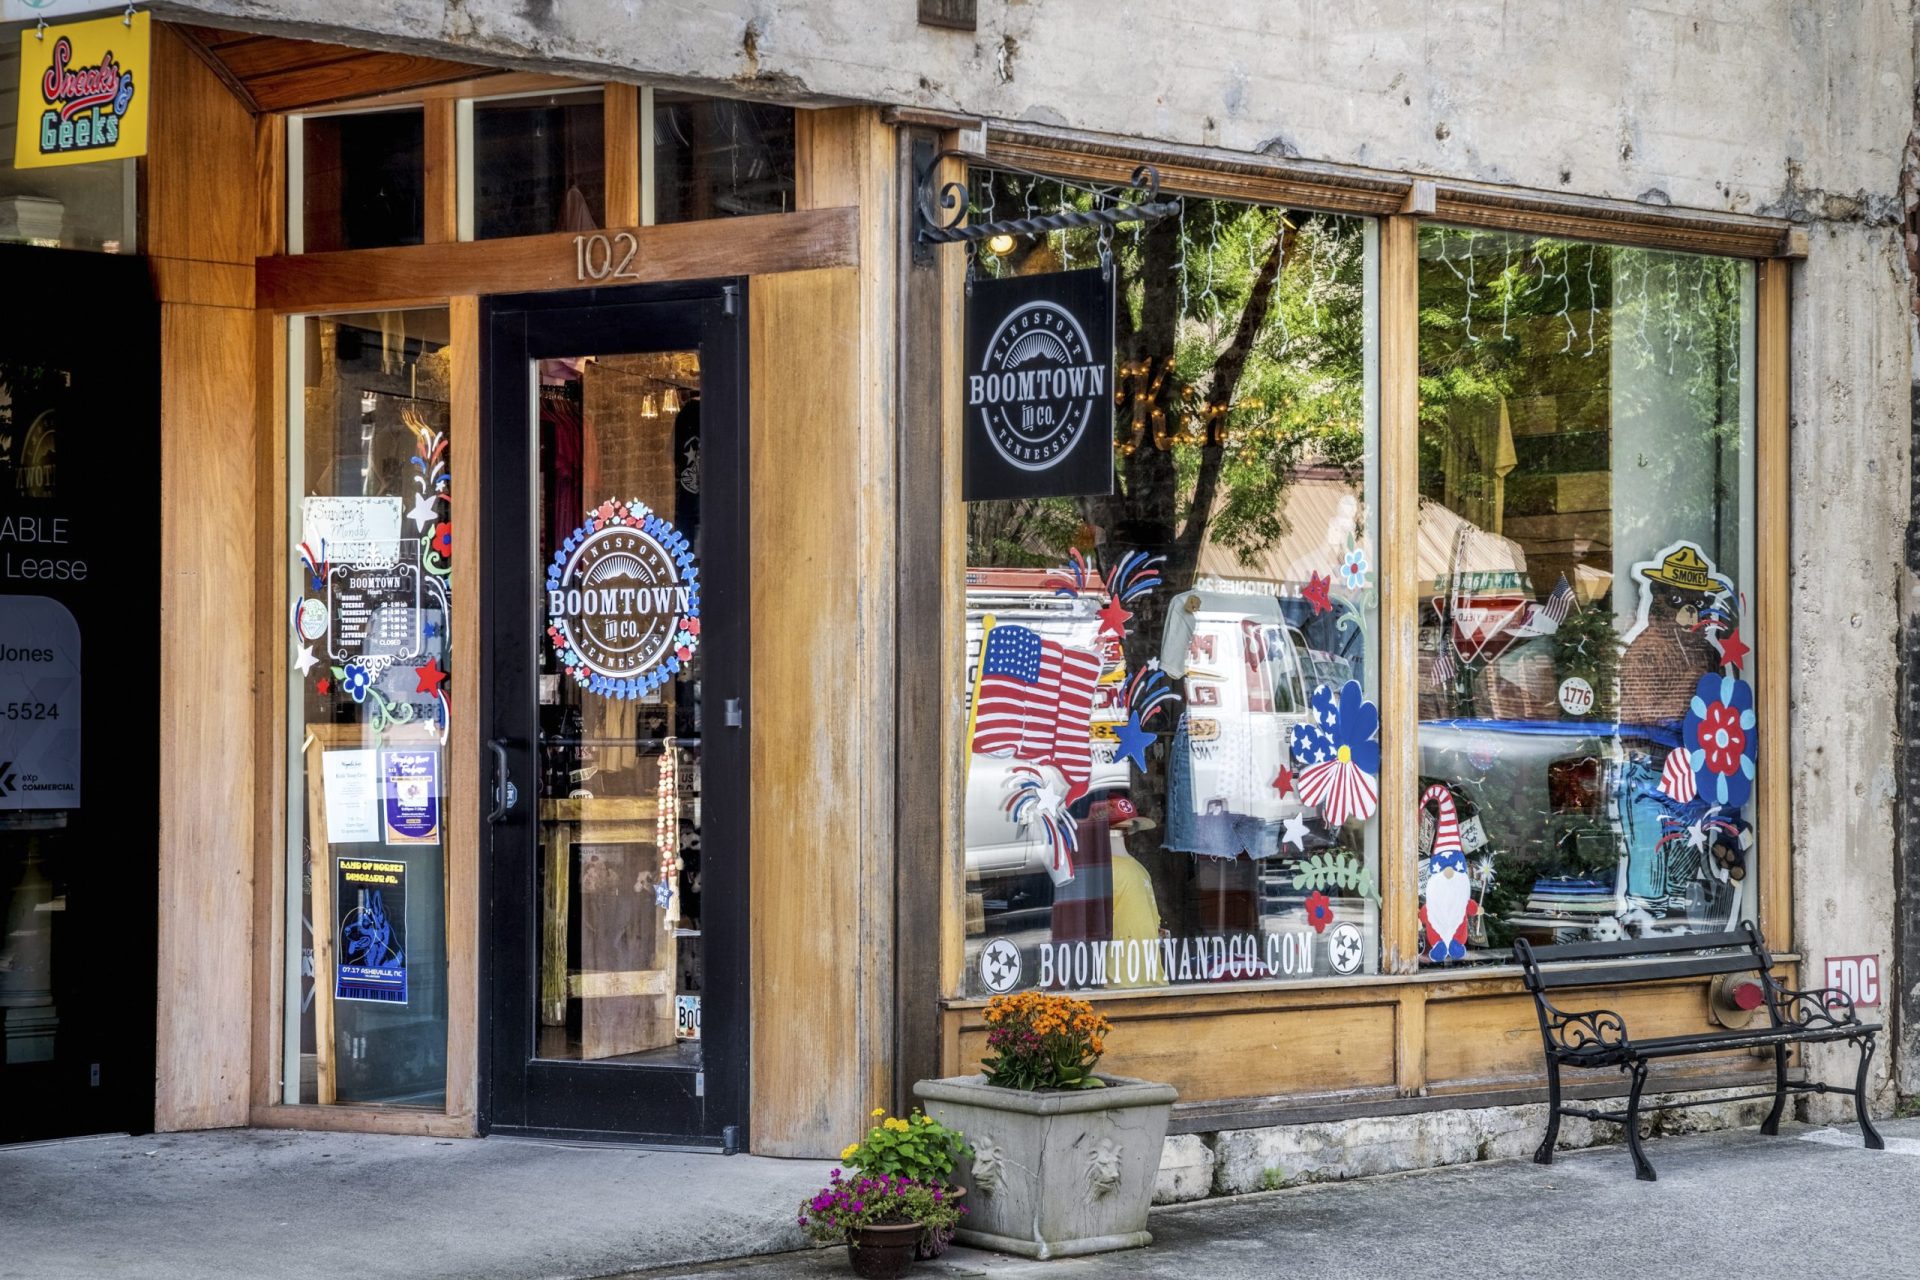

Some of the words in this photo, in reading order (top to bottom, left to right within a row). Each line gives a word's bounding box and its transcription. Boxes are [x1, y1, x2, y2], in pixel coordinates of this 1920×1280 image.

[43, 38, 119, 101] Sneaks
[114, 73, 133, 115] &
[41, 107, 118, 150] Geeks
[572, 232, 640, 281] 102
[993, 312, 1082, 363] KINGSPORT
[969, 365, 1106, 405] BOOMTOWN
[1036, 405, 1056, 426] CO.
[999, 423, 1075, 460] TENNESSEE
[0, 516, 69, 544] ABLE
[7, 553, 88, 580] Lease
[574, 537, 666, 579] KINGSPORT
[349, 576, 401, 589] BOOMTOWN
[1672, 568, 1708, 585] SMOKEY
[549, 586, 691, 616] BOOMTOWN
[620, 620, 640, 638] CO.
[0, 643, 54, 662] Jones
[580, 636, 661, 667] TENNESSEE
[1563, 685, 1592, 706] 1776
[22, 773, 39, 783] eXp
[22, 783, 75, 791] COMMERCIAL
[340, 860, 362, 870] BAND
[362, 862, 373, 871] OF
[373, 863, 404, 873] HORSES
[1039, 931, 1314, 987] BOOMTOWNANDCO.COM
[1826, 957, 1877, 1004] FDC
